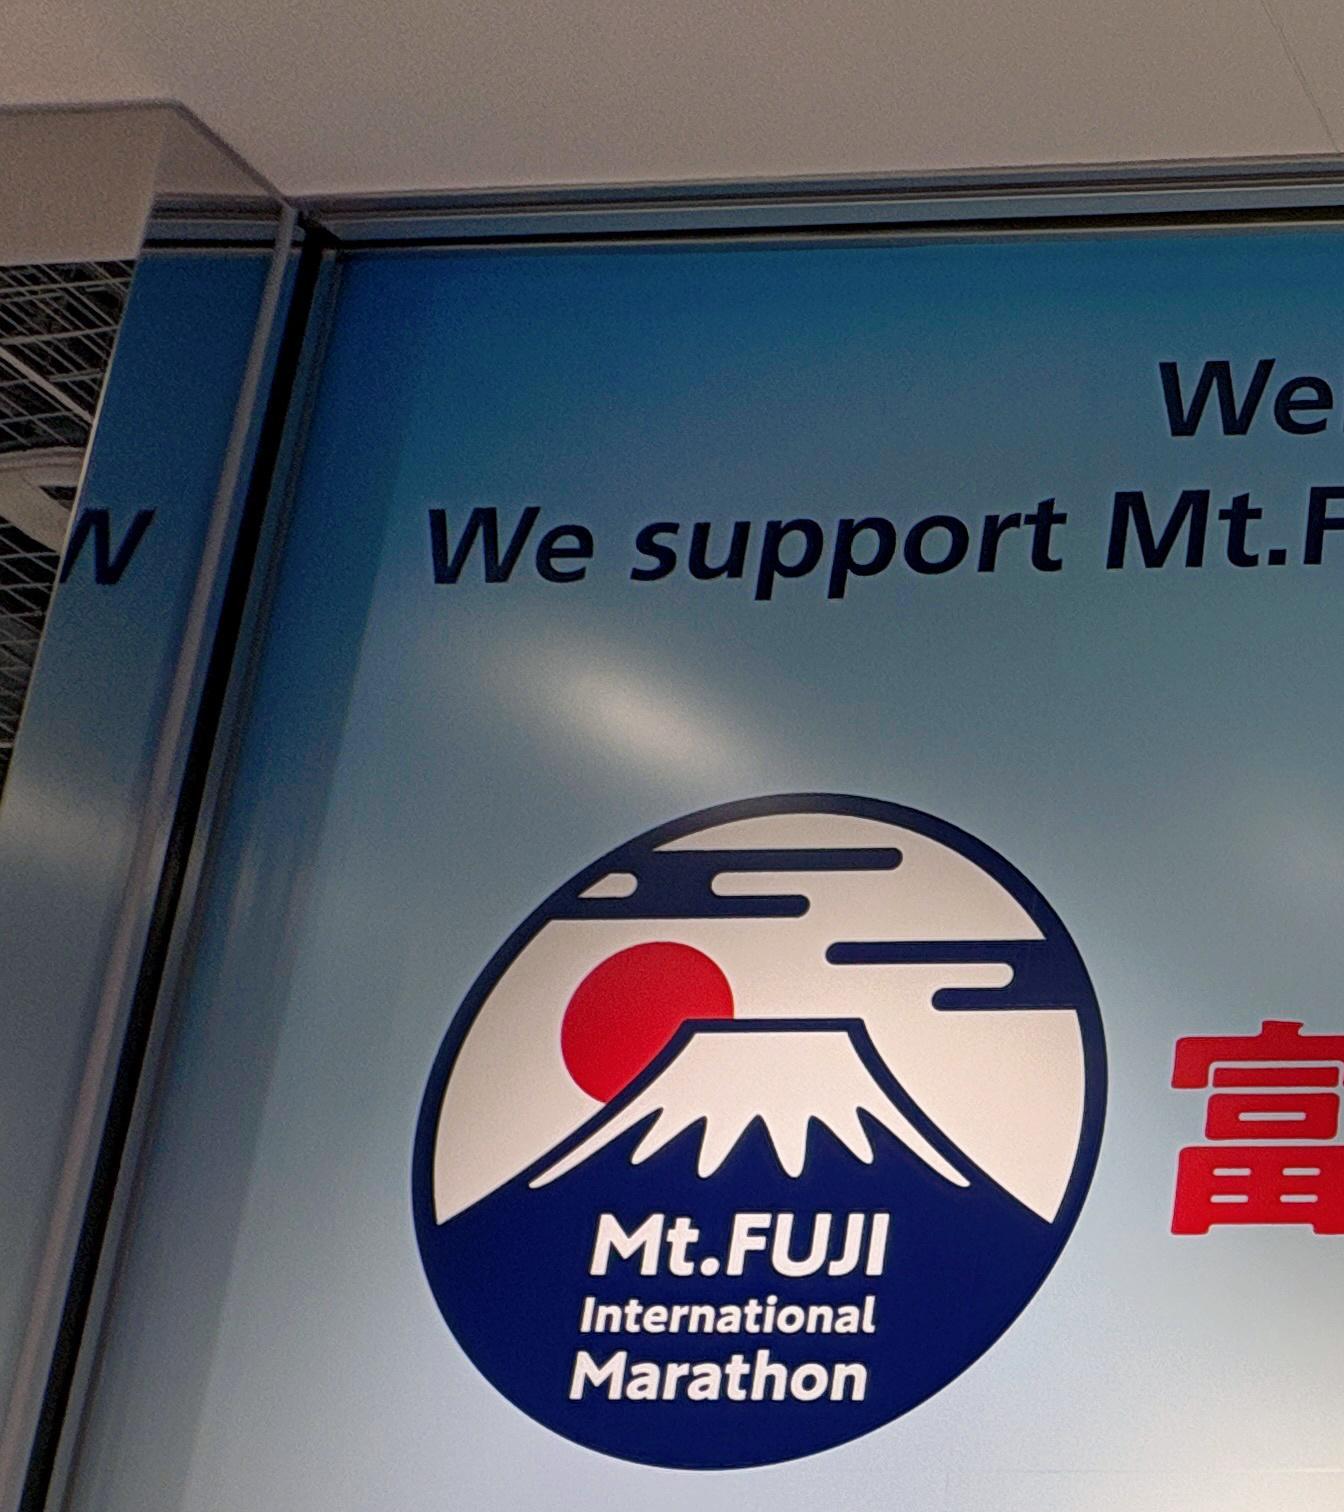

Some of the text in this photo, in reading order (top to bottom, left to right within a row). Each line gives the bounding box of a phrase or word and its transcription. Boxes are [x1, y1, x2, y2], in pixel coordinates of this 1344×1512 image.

[426, 504, 596, 586] We
[630, 496, 1068, 602] support
[588, 1212, 890, 1277] Mt.FUJI
[579, 1295, 876, 1334] International
[568, 1348, 868, 1400] Marathon
